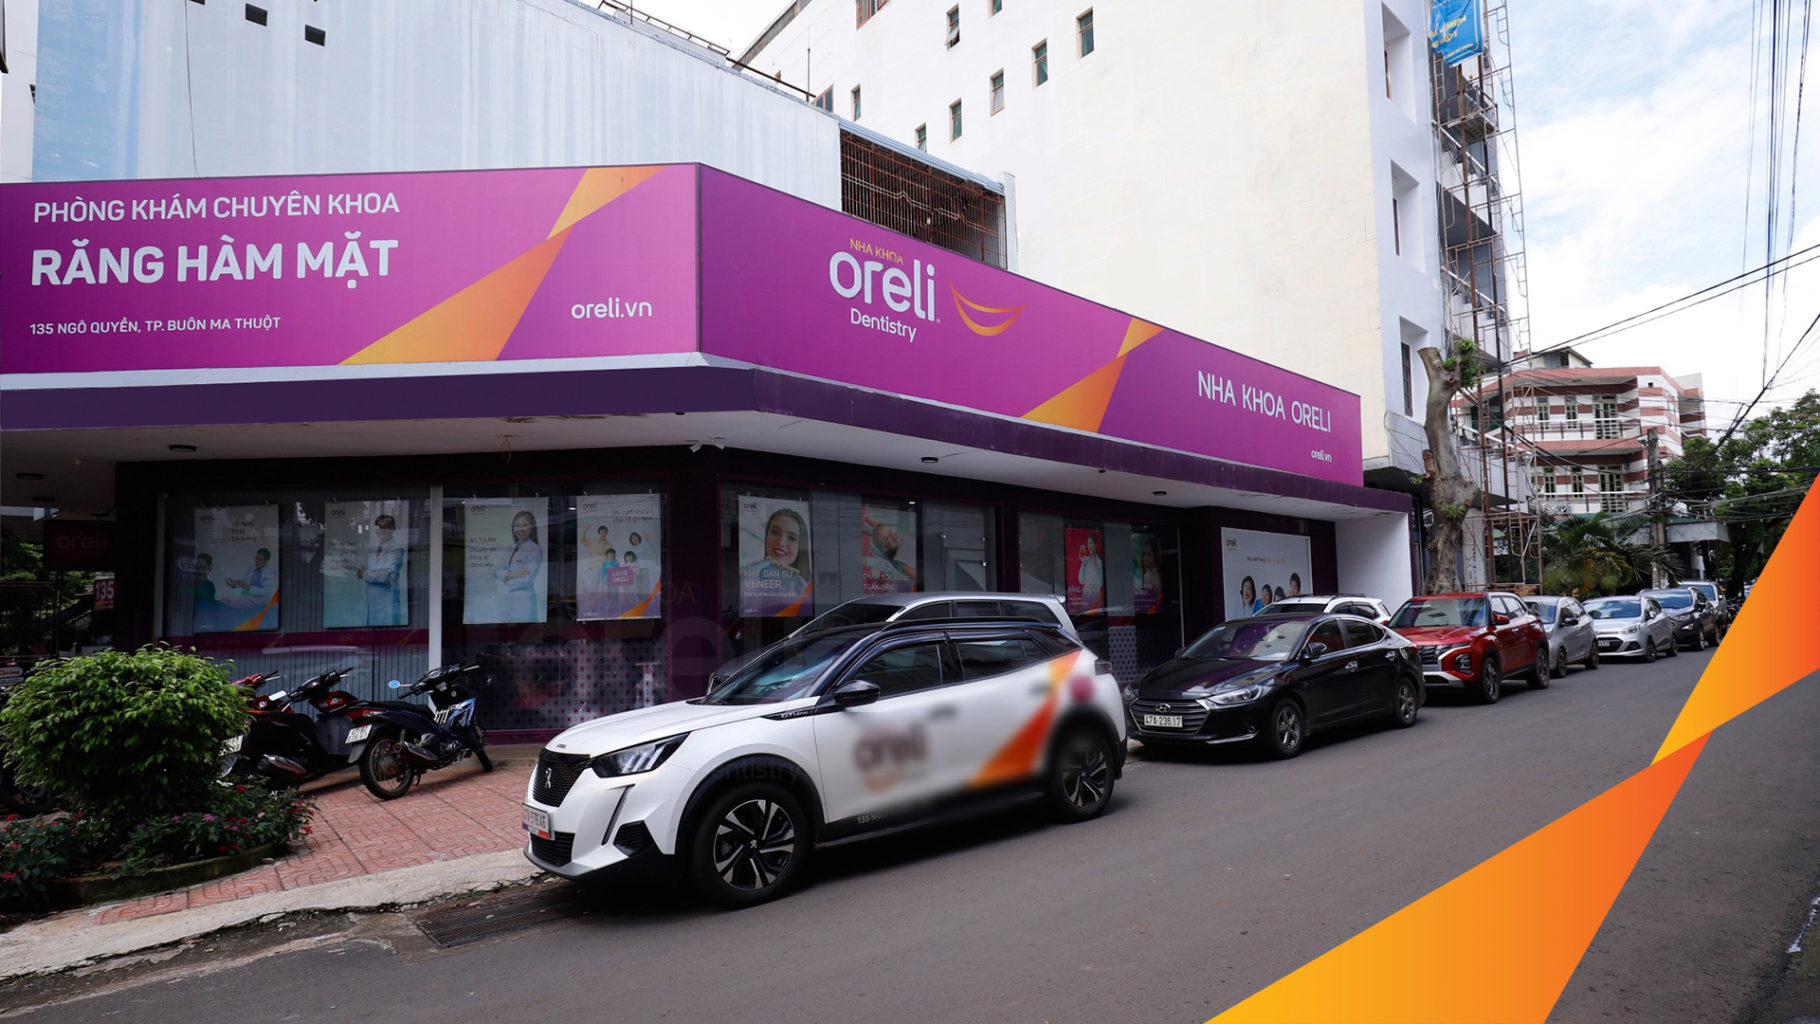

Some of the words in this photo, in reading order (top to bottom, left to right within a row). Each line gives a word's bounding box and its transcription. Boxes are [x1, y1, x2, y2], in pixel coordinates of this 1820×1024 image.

[33, 195, 125, 223] PHÒNG
[131, 193, 207, 221] KHÁM
[213, 190, 321, 218] CHUYÊN
[328, 192, 400, 215] KHOA
[31, 238, 164, 286] RĂNG
[177, 234, 283, 283] HÀM
[297, 230, 399, 289] MẶT
[849, 237, 873, 256] NHA
[875, 246, 905, 265] KHOA
[829, 251, 935, 322] oreli
[571, 298, 653, 320] oreli.vn
[30, 322, 53, 335] 135
[57, 318, 87, 334] NGÔ
[145, 319, 164, 332] TP.
[167, 317, 206, 331] BUÔN
[210, 318, 231, 330] MA
[235, 314, 281, 331] THUỘT
[851, 307, 917, 343] Dentistry
[1198, 370, 1236, 406] NHA
[1242, 384, 1286, 420] KHOA
[1291, 400, 1331, 432] ORELI
[1310, 449, 1333, 463] oreli.vn
[95, 580, 115, 601] 135
[744, 579, 782, 589] VENEER
